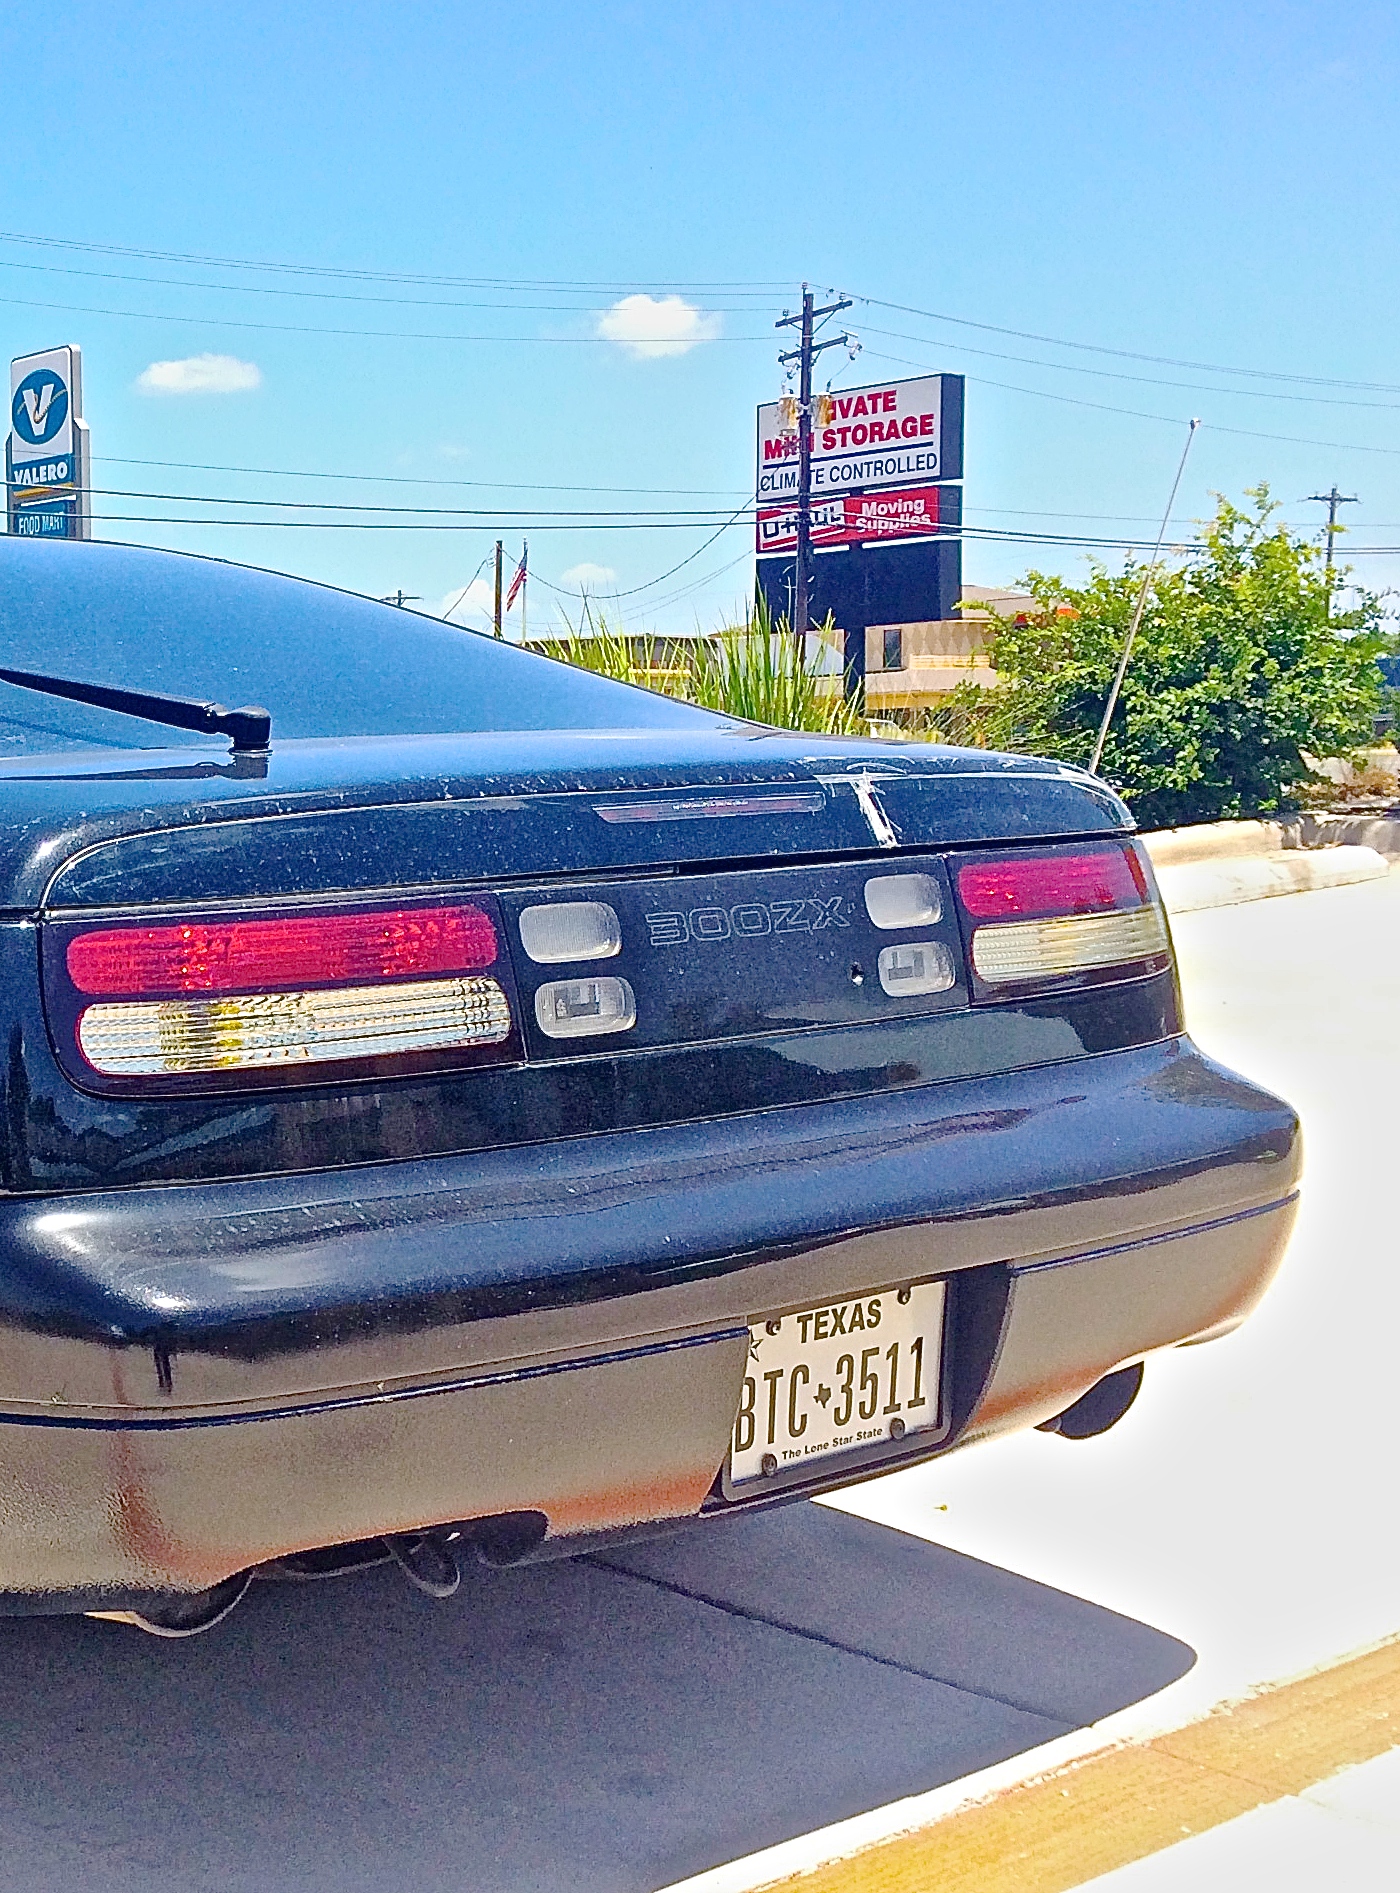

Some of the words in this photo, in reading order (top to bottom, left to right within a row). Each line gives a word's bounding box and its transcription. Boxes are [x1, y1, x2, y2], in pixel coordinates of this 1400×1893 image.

[822, 414, 935, 451] STORAGE
[13, 461, 69, 485] VALERO
[760, 467, 825, 492] CLIME
[829, 453, 938, 483] CONTROLLED
[855, 513, 931, 535] Supplies
[861, 498, 925, 517] Moving
[18, 515, 40, 535] FOOD
[645, 896, 850, 946] 300ZX
[797, 1299, 882, 1344] TEXAS
[735, 1364, 810, 1453] BTC
[833, 1336, 926, 1427] 3511
[781, 1449, 802, 1460] The
[804, 1442, 830, 1455] Lone
[832, 1435, 854, 1448] Star
[856, 1428, 883, 1441] State
